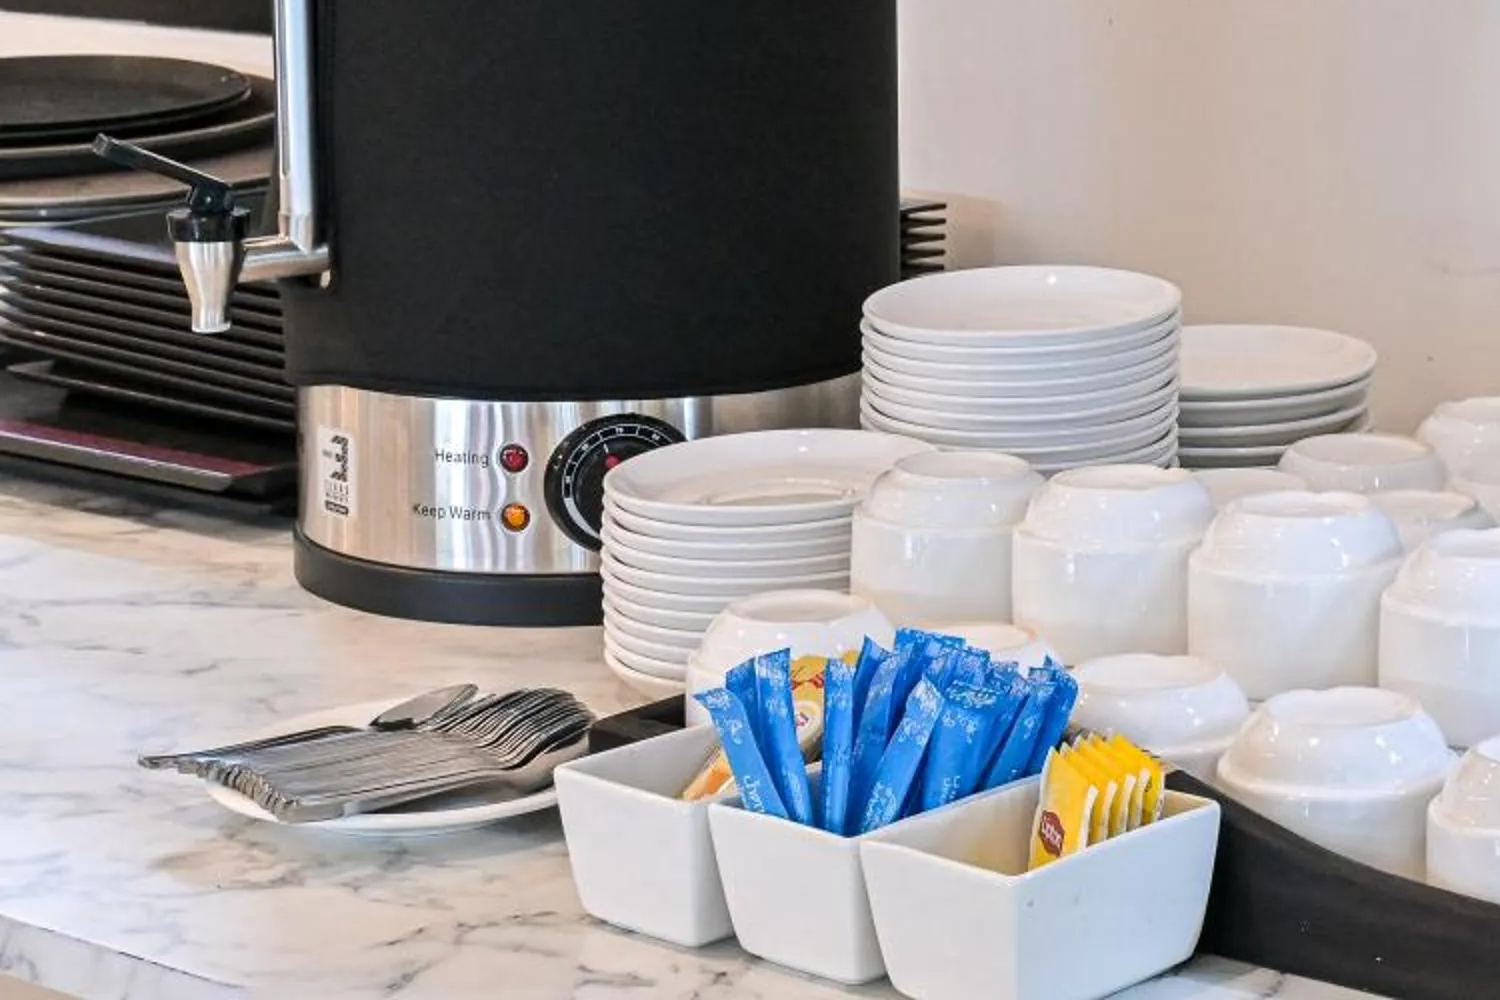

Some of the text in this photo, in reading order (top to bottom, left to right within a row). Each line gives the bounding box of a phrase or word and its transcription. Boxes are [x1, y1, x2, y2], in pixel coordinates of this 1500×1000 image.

[434, 449, 489, 468] Heating
[412, 502, 491, 521] Keep Warm
